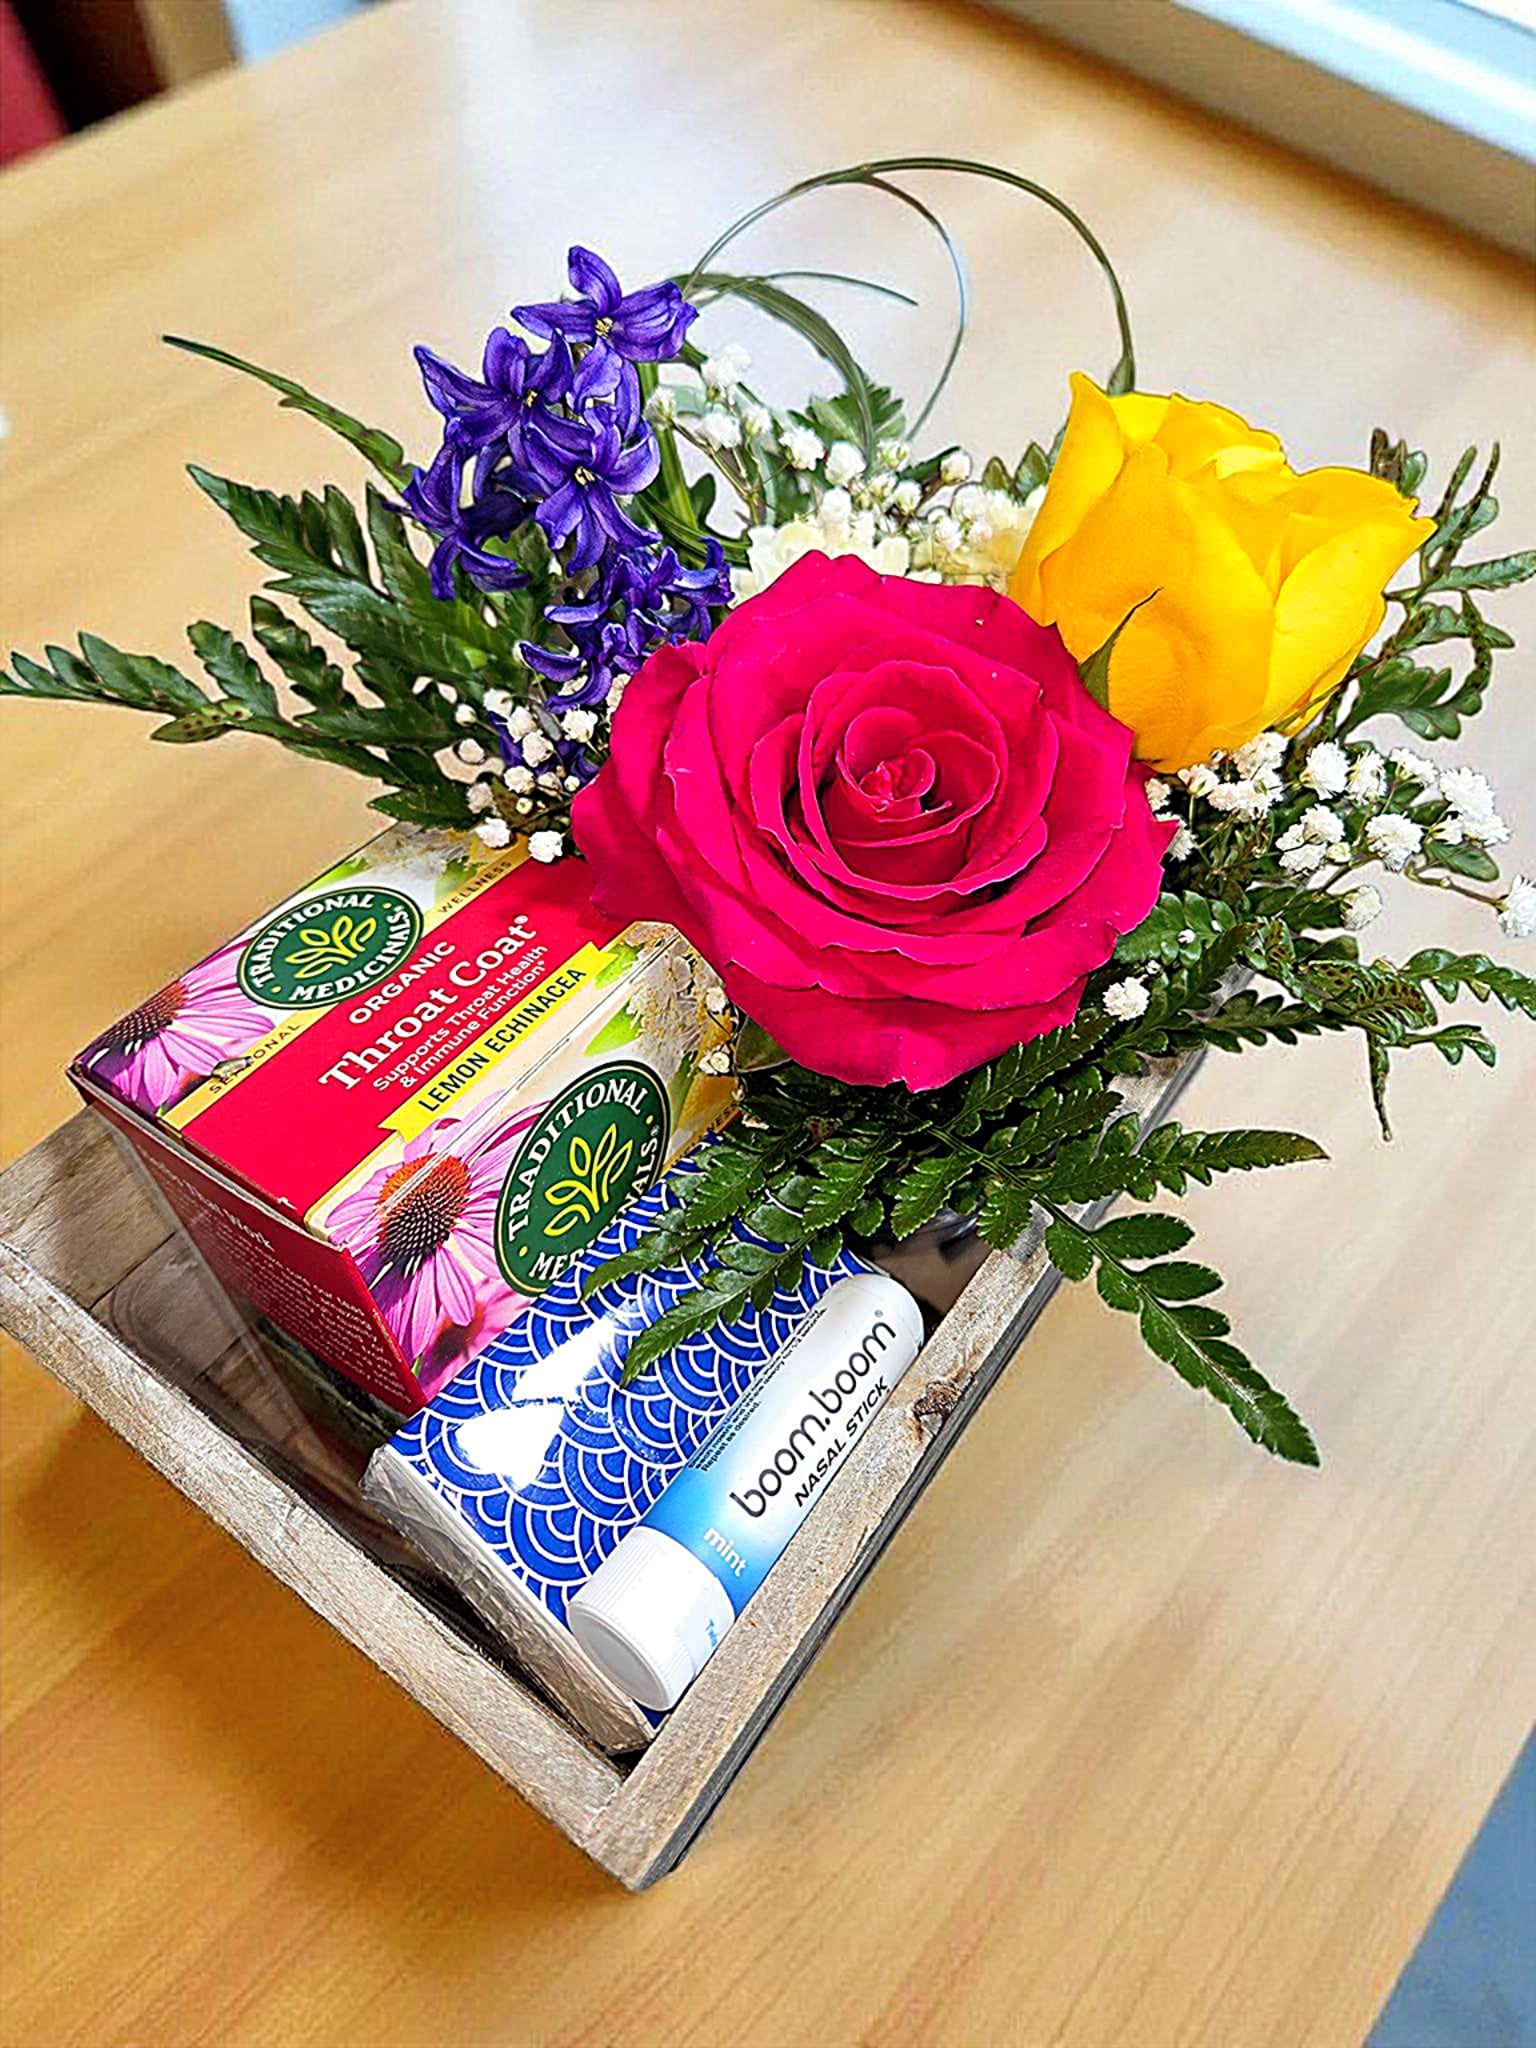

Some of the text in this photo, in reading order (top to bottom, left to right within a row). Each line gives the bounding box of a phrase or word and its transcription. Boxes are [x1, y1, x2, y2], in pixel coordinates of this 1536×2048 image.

[438, 860, 513, 913] WELLNESS
[250, 893, 375, 988] TRADITIONAL
[288, 909, 411, 1001] MEDICINALS
[349, 941, 456, 1025] ORGANIC
[209, 1023, 302, 1095] SEONAL
[318, 987, 459, 1090] Throat
[373, 945, 549, 1092] Supports Throat Health
[400, 1072, 418, 1089] &
[414, 1021, 481, 1077] Immune
[418, 968, 587, 1112] LEMON ECHINACEA
[508, 1078, 649, 1242] TRADITIONAL
[528, 1136, 659, 1281] MENALS
[700, 1442, 729, 1472] Repeat
[725, 1431, 737, 1442] as
[794, 1375, 890, 1507] NASAL STICK
[703, 1527, 747, 1577] mint
